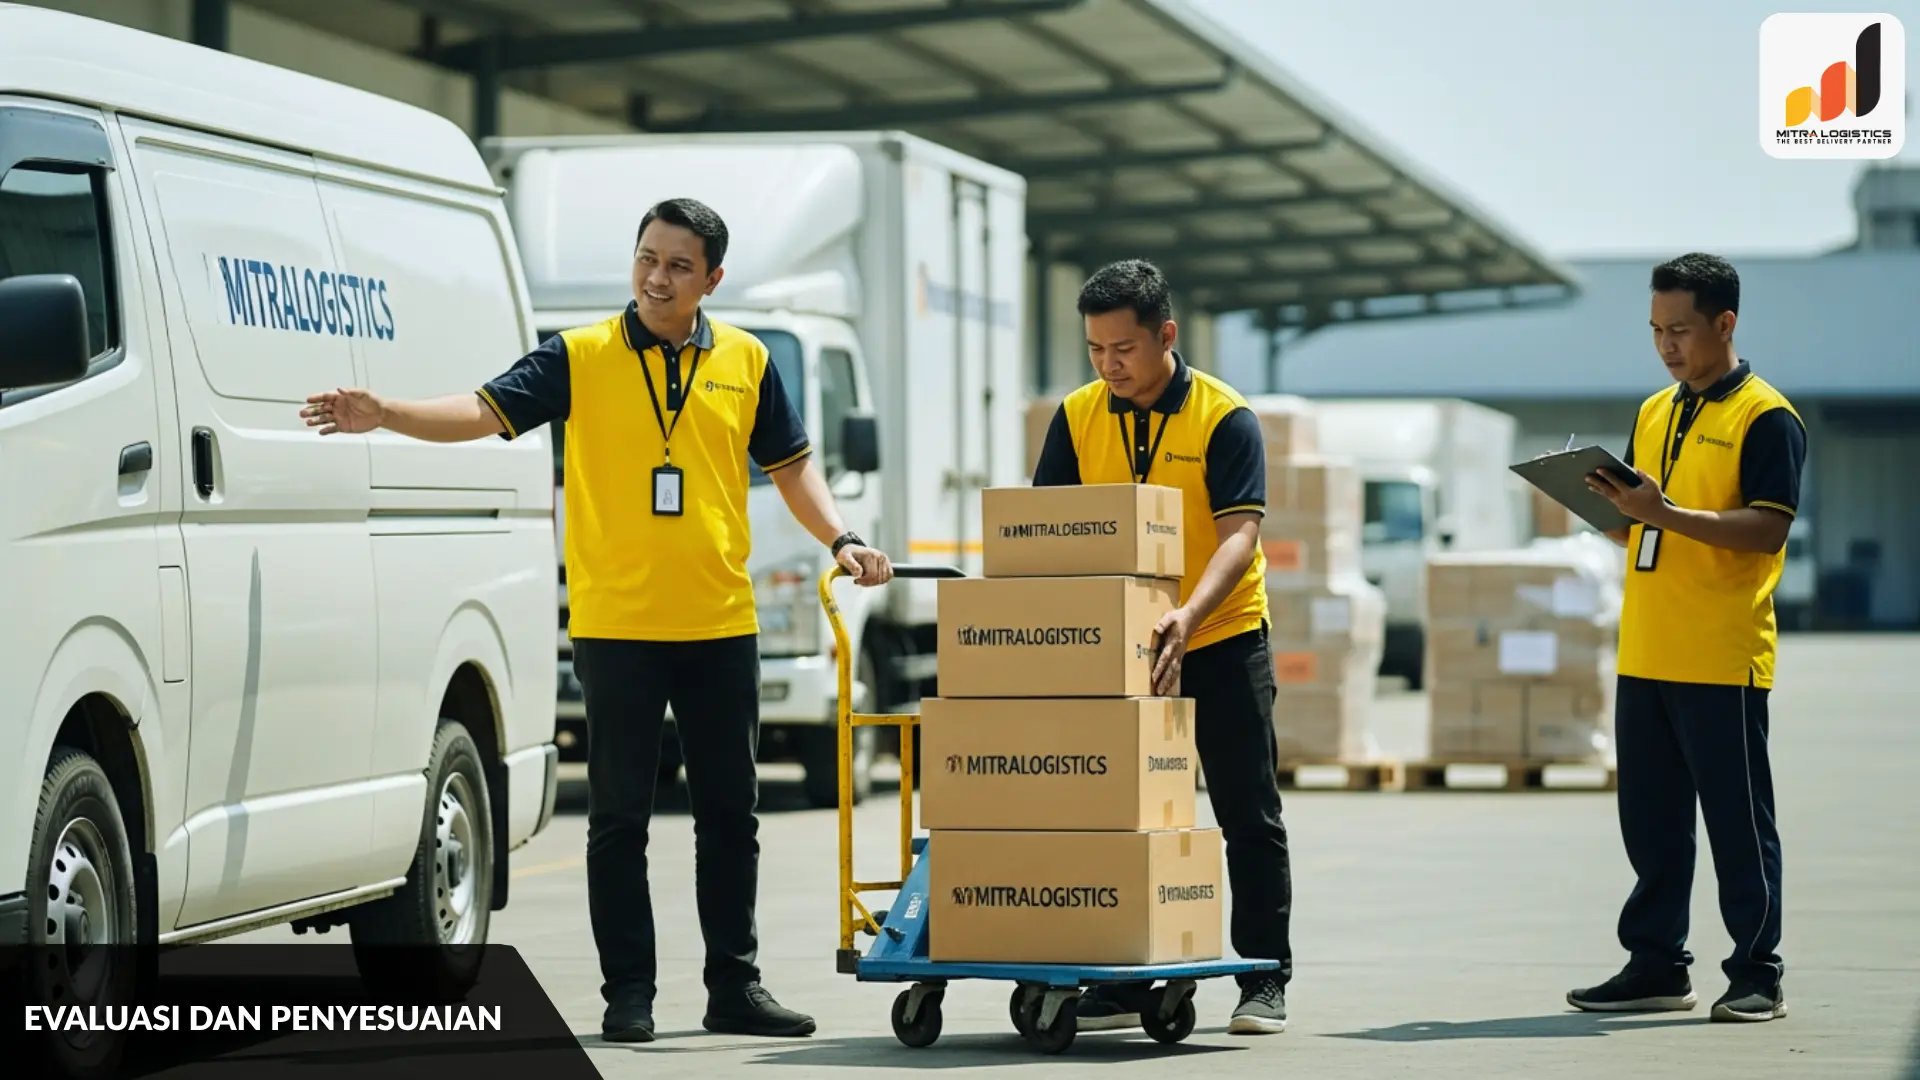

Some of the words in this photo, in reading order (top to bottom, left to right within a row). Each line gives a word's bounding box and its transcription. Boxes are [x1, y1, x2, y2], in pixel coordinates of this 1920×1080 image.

[218, 256, 395, 341] MITRALOGISTICS
[978, 627, 1102, 646] MITRALOGISTICS
[966, 755, 1107, 776] MITRALOGISTICS
[975, 886, 1119, 908] MITRALOGISTICS
